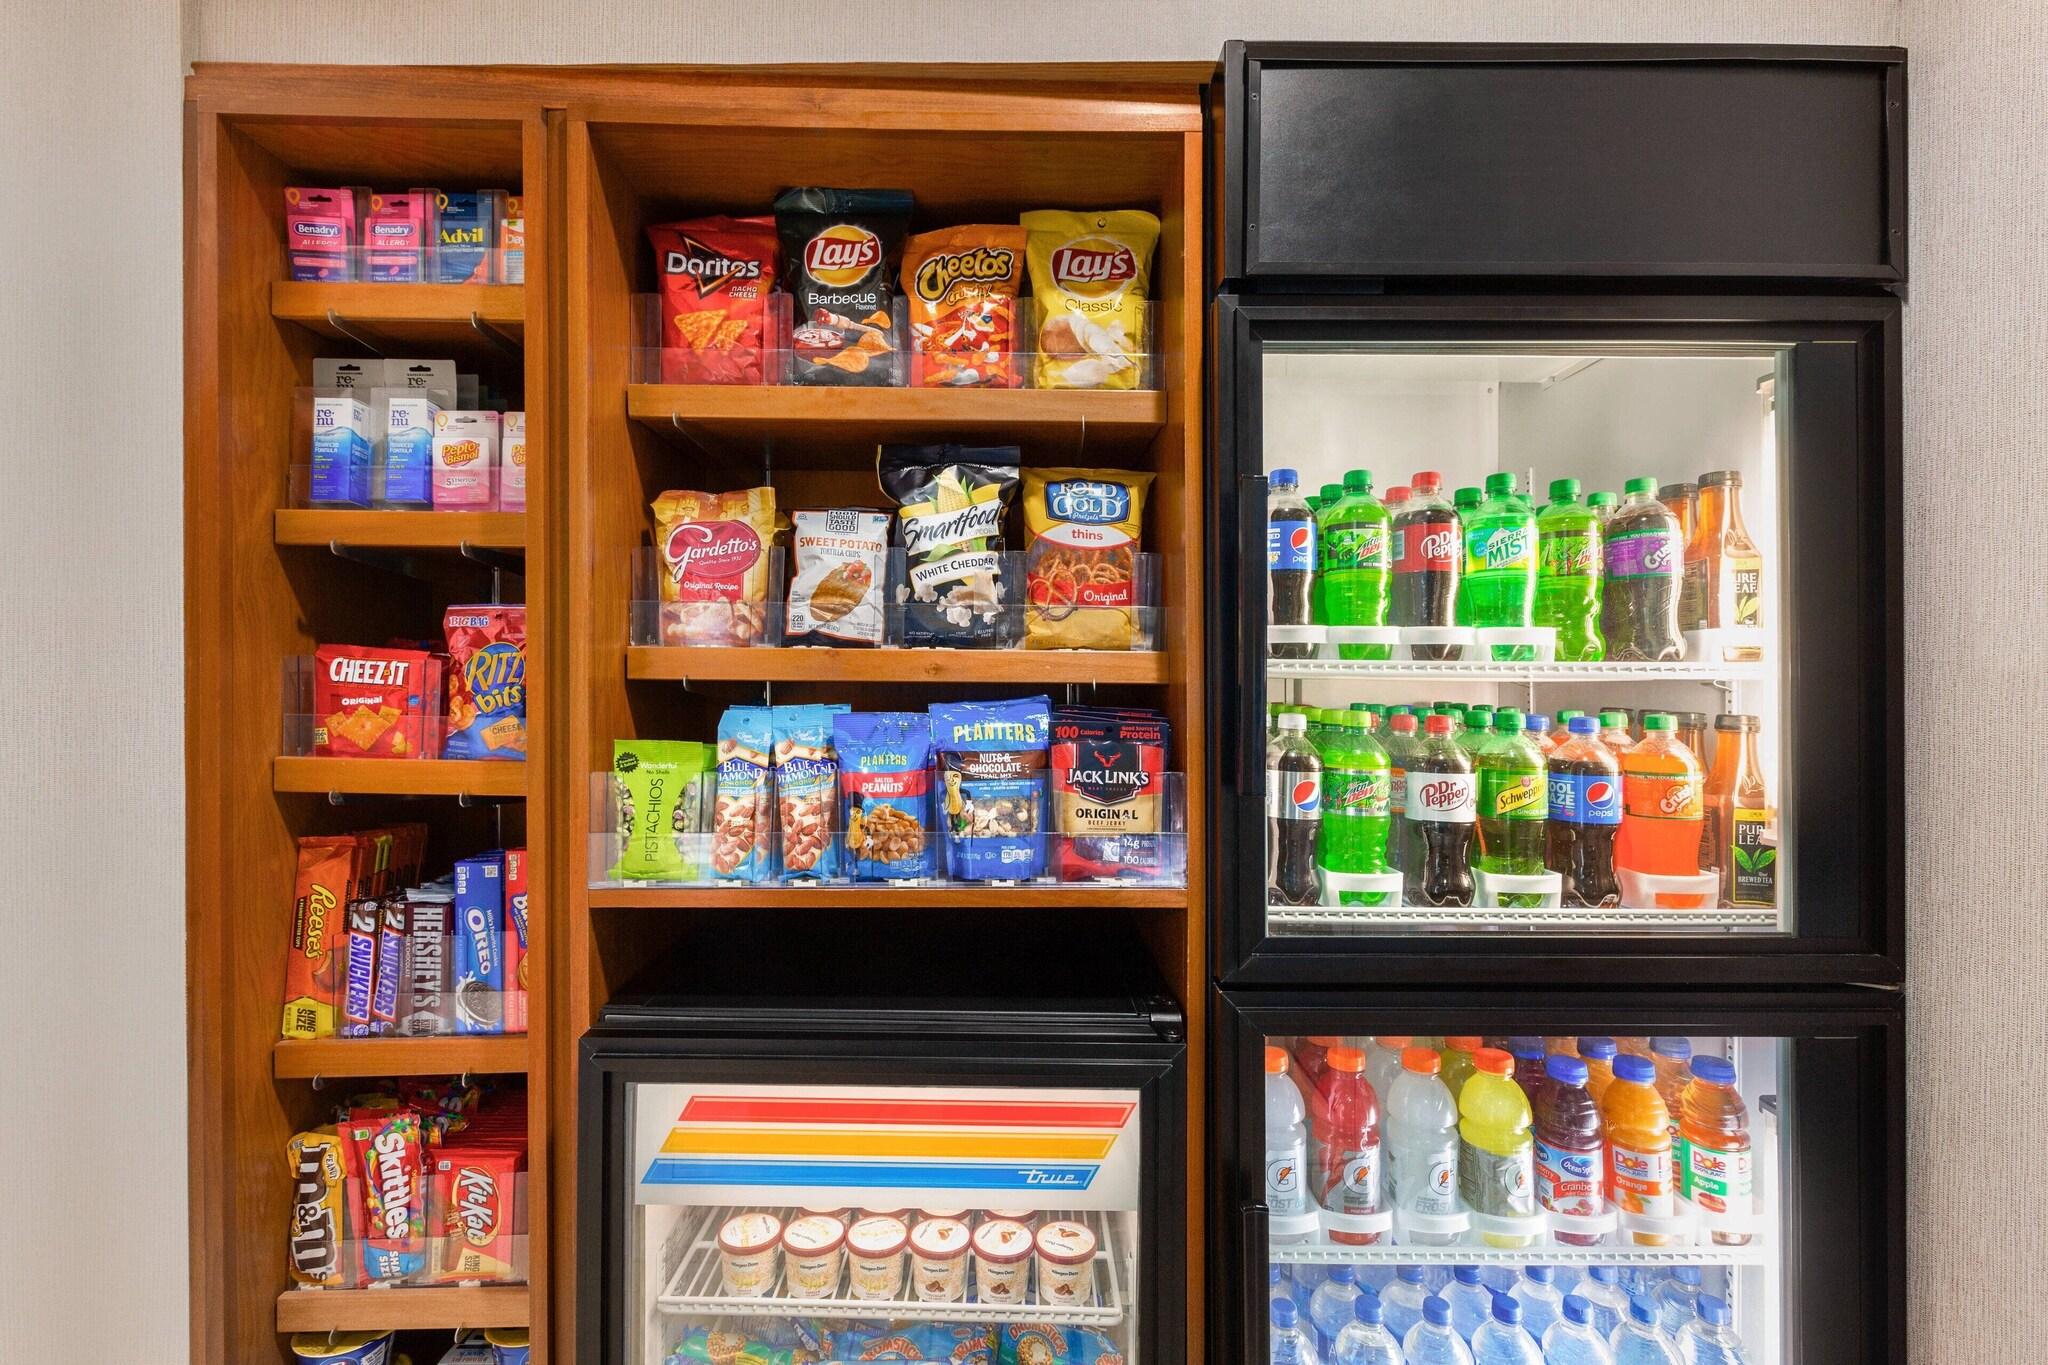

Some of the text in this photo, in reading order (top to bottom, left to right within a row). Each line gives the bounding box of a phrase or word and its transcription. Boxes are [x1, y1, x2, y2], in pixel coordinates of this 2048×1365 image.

[298, 224, 339, 236] Benadryl
[374, 225, 410, 236] Benadry
[439, 227, 484, 244] Advil
[809, 236, 876, 271] Lay's
[666, 252, 761, 279] Doritos
[1058, 248, 1130, 282] Lay's
[916, 247, 1014, 304] Cheetos
[807, 293, 877, 305] Barbecue
[1064, 298, 1123, 313] Classic
[317, 417, 334, 426] nu
[391, 418, 409, 426] nu
[447, 450, 479, 464] Bismol
[1060, 482, 1118, 498] ROLD
[1053, 496, 1121, 519] GOLD
[1072, 512, 1099, 522] Pretzels
[828, 524, 856, 532] GOOD
[903, 500, 1003, 550] Smartfood
[1071, 528, 1104, 542] thins
[799, 536, 883, 553] SWEET POTATO
[1488, 536, 1530, 567] MIST
[665, 524, 759, 583] Gardetto's
[845, 550, 861, 558] CHIPS
[915, 556, 995, 582] WHITE CHEDDAR
[683, 581, 740, 593] Original Recipe
[1083, 590, 1129, 605] Original
[450, 616, 489, 627] BIG BAG
[792, 614, 804, 622] 220
[329, 657, 409, 686] CHEEZ-IT
[465, 651, 523, 692] RITZ
[475, 686, 522, 714] bits
[953, 723, 1036, 744] PLANTERS
[1055, 726, 1079, 739] 100
[1120, 730, 1161, 739] Protein
[723, 761, 750, 773] BLUE
[784, 760, 811, 774] BLUE
[860, 754, 908, 767] PLANTERS
[969, 762, 1022, 773] CHOCOLATE
[719, 767, 764, 781] IAMOND
[1066, 769, 1149, 786] JACK LINK'S
[862, 781, 904, 793] PEANUTS
[1439, 781, 1457, 794] Dr
[1549, 783, 1575, 795] OOL
[1425, 784, 1467, 808] Pepper
[1500, 782, 1545, 810] Schwepp
[645, 778, 664, 862] PISTACHIOS
[1075, 808, 1139, 820] ORIGINAL
[1738, 824, 1766, 835] PUR
[1123, 838, 1140, 850] 14g
[1738, 834, 1762, 845] LEA
[1123, 855, 1139, 865] 100
[1737, 876, 1773, 884] BREWED TEA
[305, 884, 337, 960] Reese's
[352, 912, 376, 933] 2
[386, 908, 405, 930] 2
[466, 908, 491, 975] OREO
[348, 933, 373, 1019] SNICKERS
[296, 1008, 307, 1031] SIZE
[306, 1009, 317, 1032] KING
[1563, 1161, 1582, 1173] Ocean
[1615, 1150, 1649, 1170] Dole
[1693, 1150, 1726, 1171] Dole
[374, 1132, 411, 1239] Skittles
[1615, 1175, 1648, 1190] Orange
[1693, 1175, 1719, 1191] Apple
[1416, 1200, 1448, 1211] FROS
